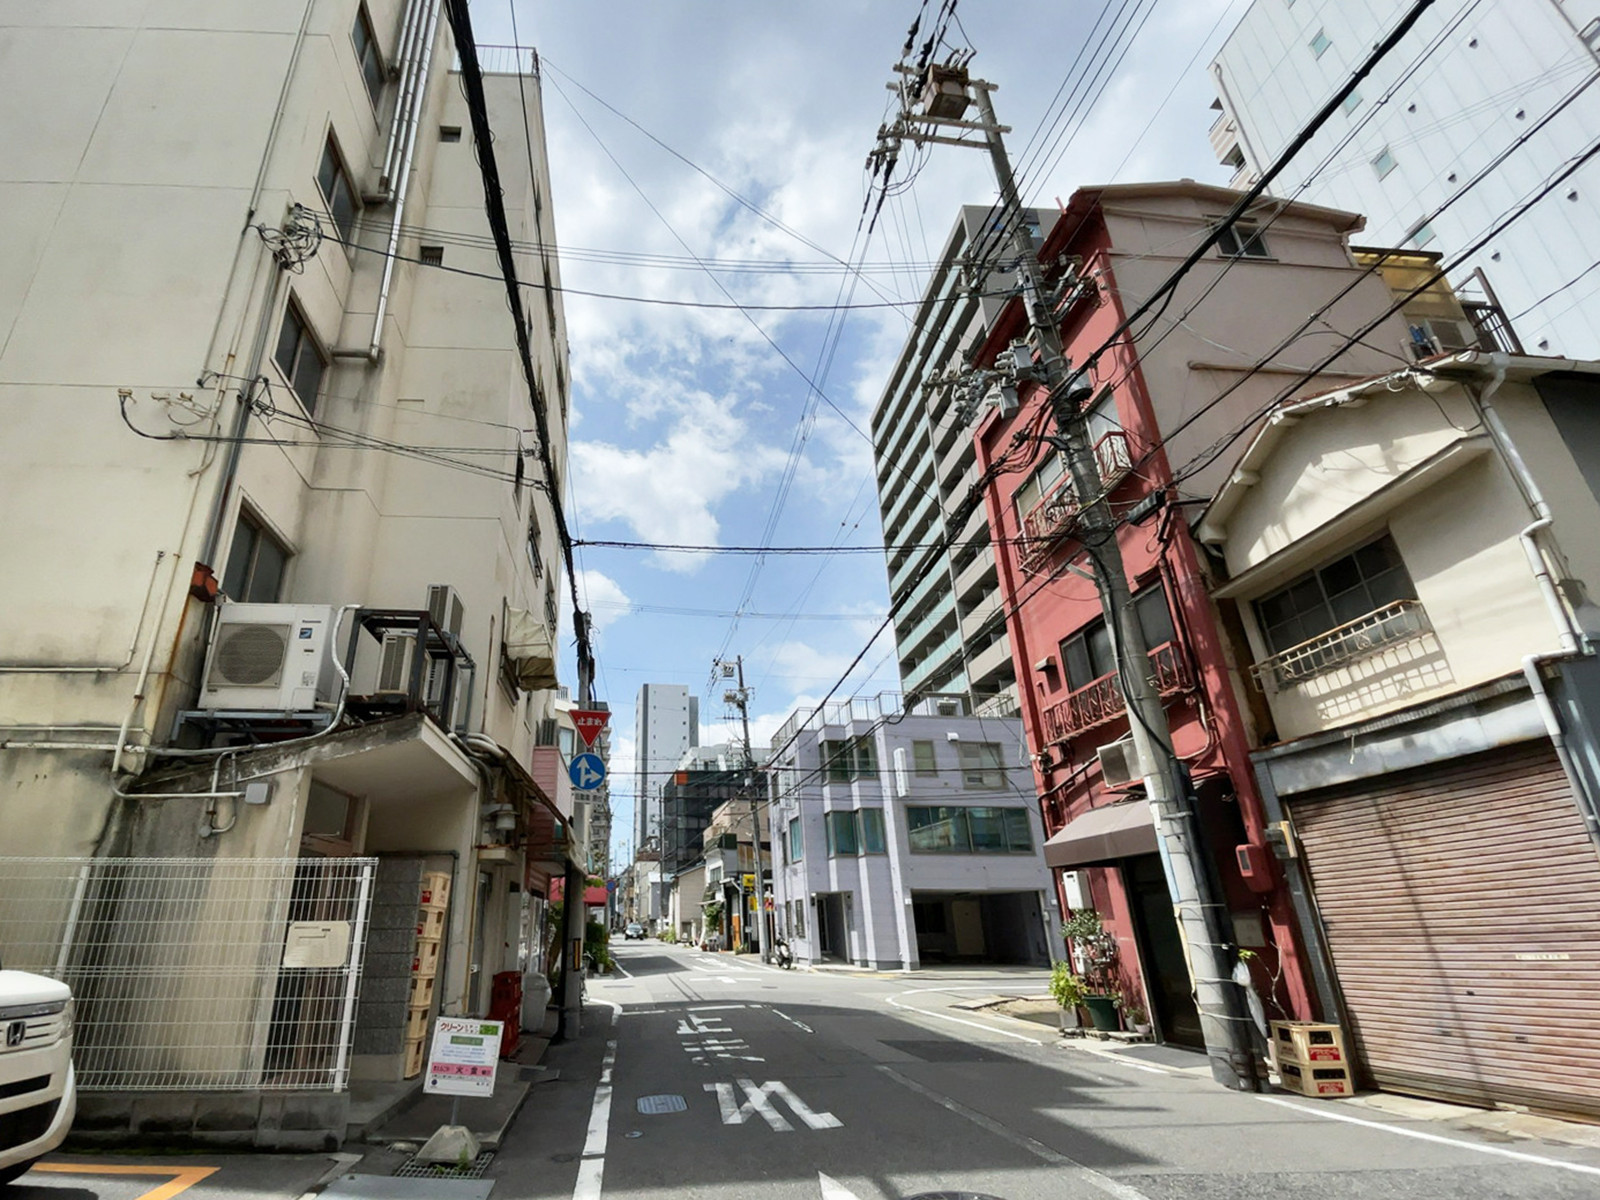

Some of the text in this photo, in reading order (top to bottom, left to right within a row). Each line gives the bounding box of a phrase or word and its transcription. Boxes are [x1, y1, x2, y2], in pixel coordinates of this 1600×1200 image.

[577, 717, 602, 726] 止まれ
[440, 1022, 464, 1032] クリーン
